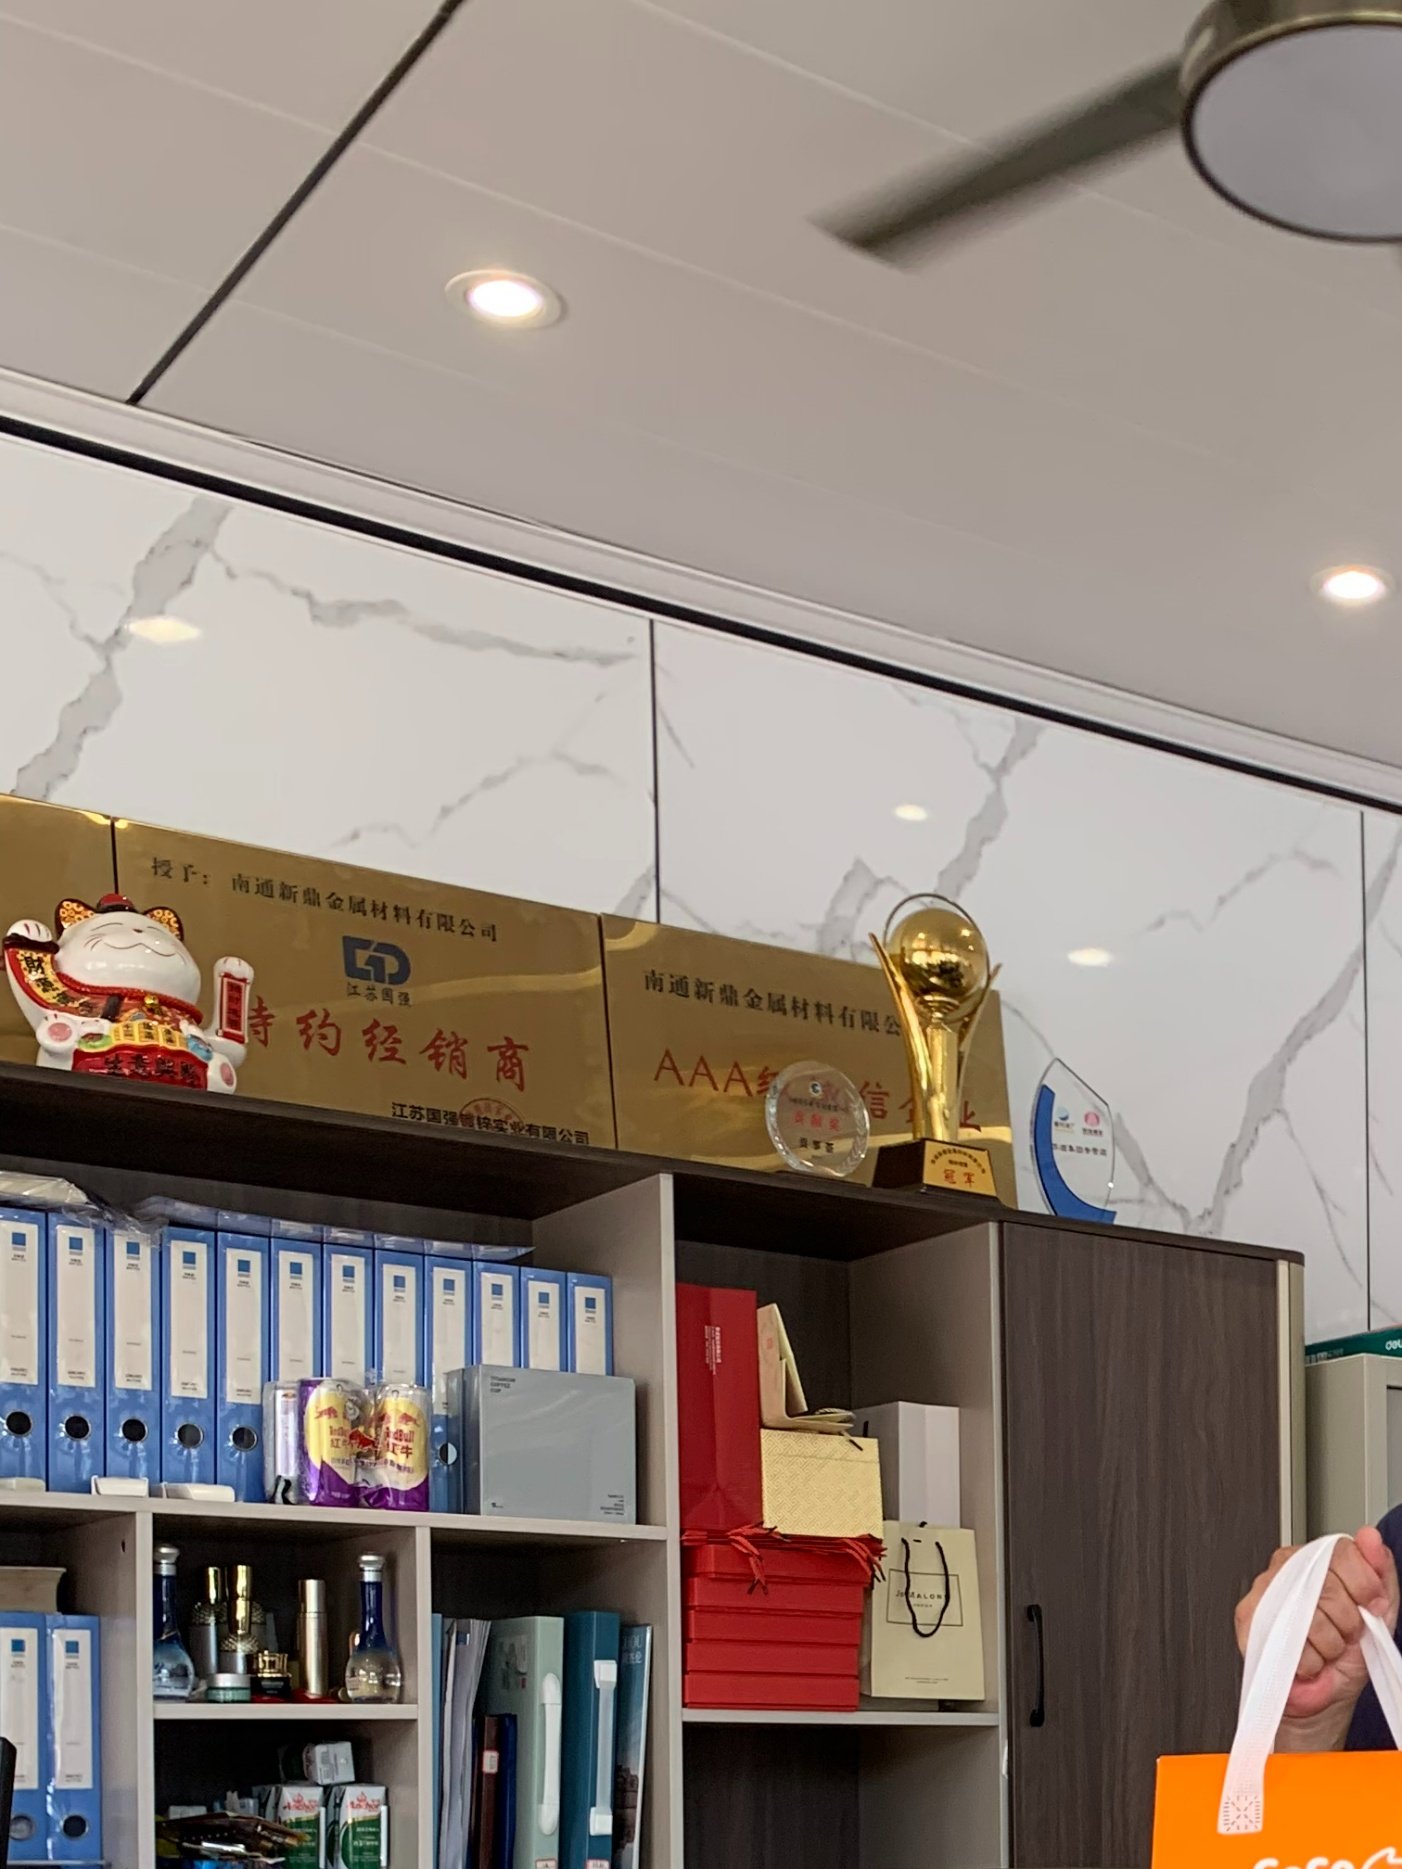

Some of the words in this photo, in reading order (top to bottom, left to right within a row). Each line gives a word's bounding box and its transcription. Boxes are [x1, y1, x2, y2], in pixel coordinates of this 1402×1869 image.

[231, 873, 498, 942] 南通新鼎金属材料有限公司
[347, 983, 412, 1008] 江苏国强
[643, 969, 902, 1038] 南通新鼎金属材料有限公
